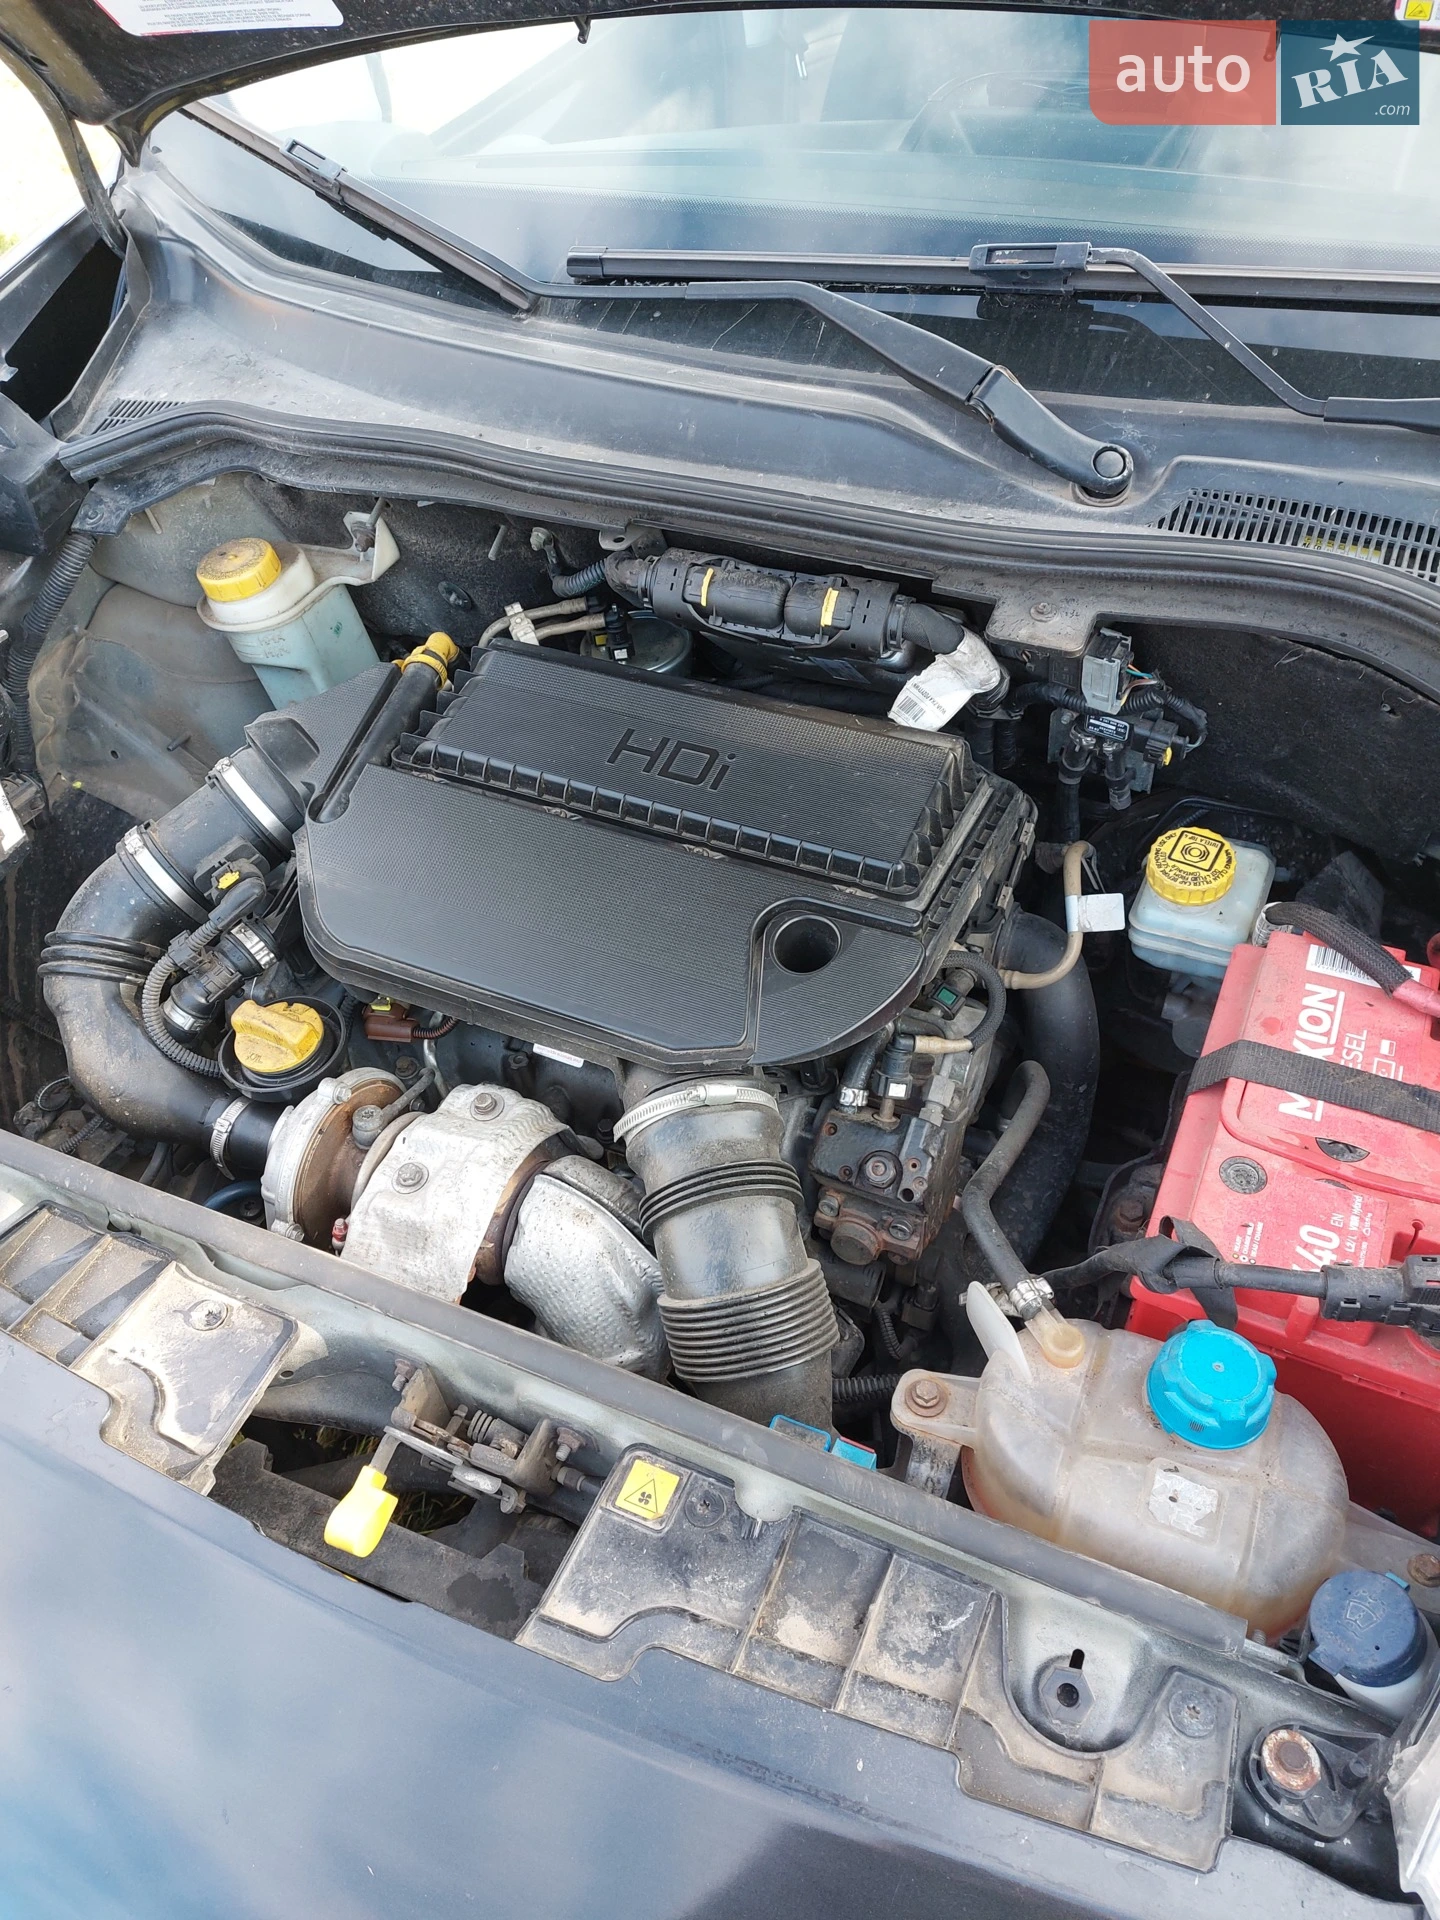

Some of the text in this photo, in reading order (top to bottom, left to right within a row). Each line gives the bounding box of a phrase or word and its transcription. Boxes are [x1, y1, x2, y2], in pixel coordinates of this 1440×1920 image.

[606, 728, 736, 791] HDi
[1278, 983, 1338, 1121] MXION
[1340, 1029, 1368, 1070] ESEL
[1291, 1212, 1345, 1273] 40 EN
